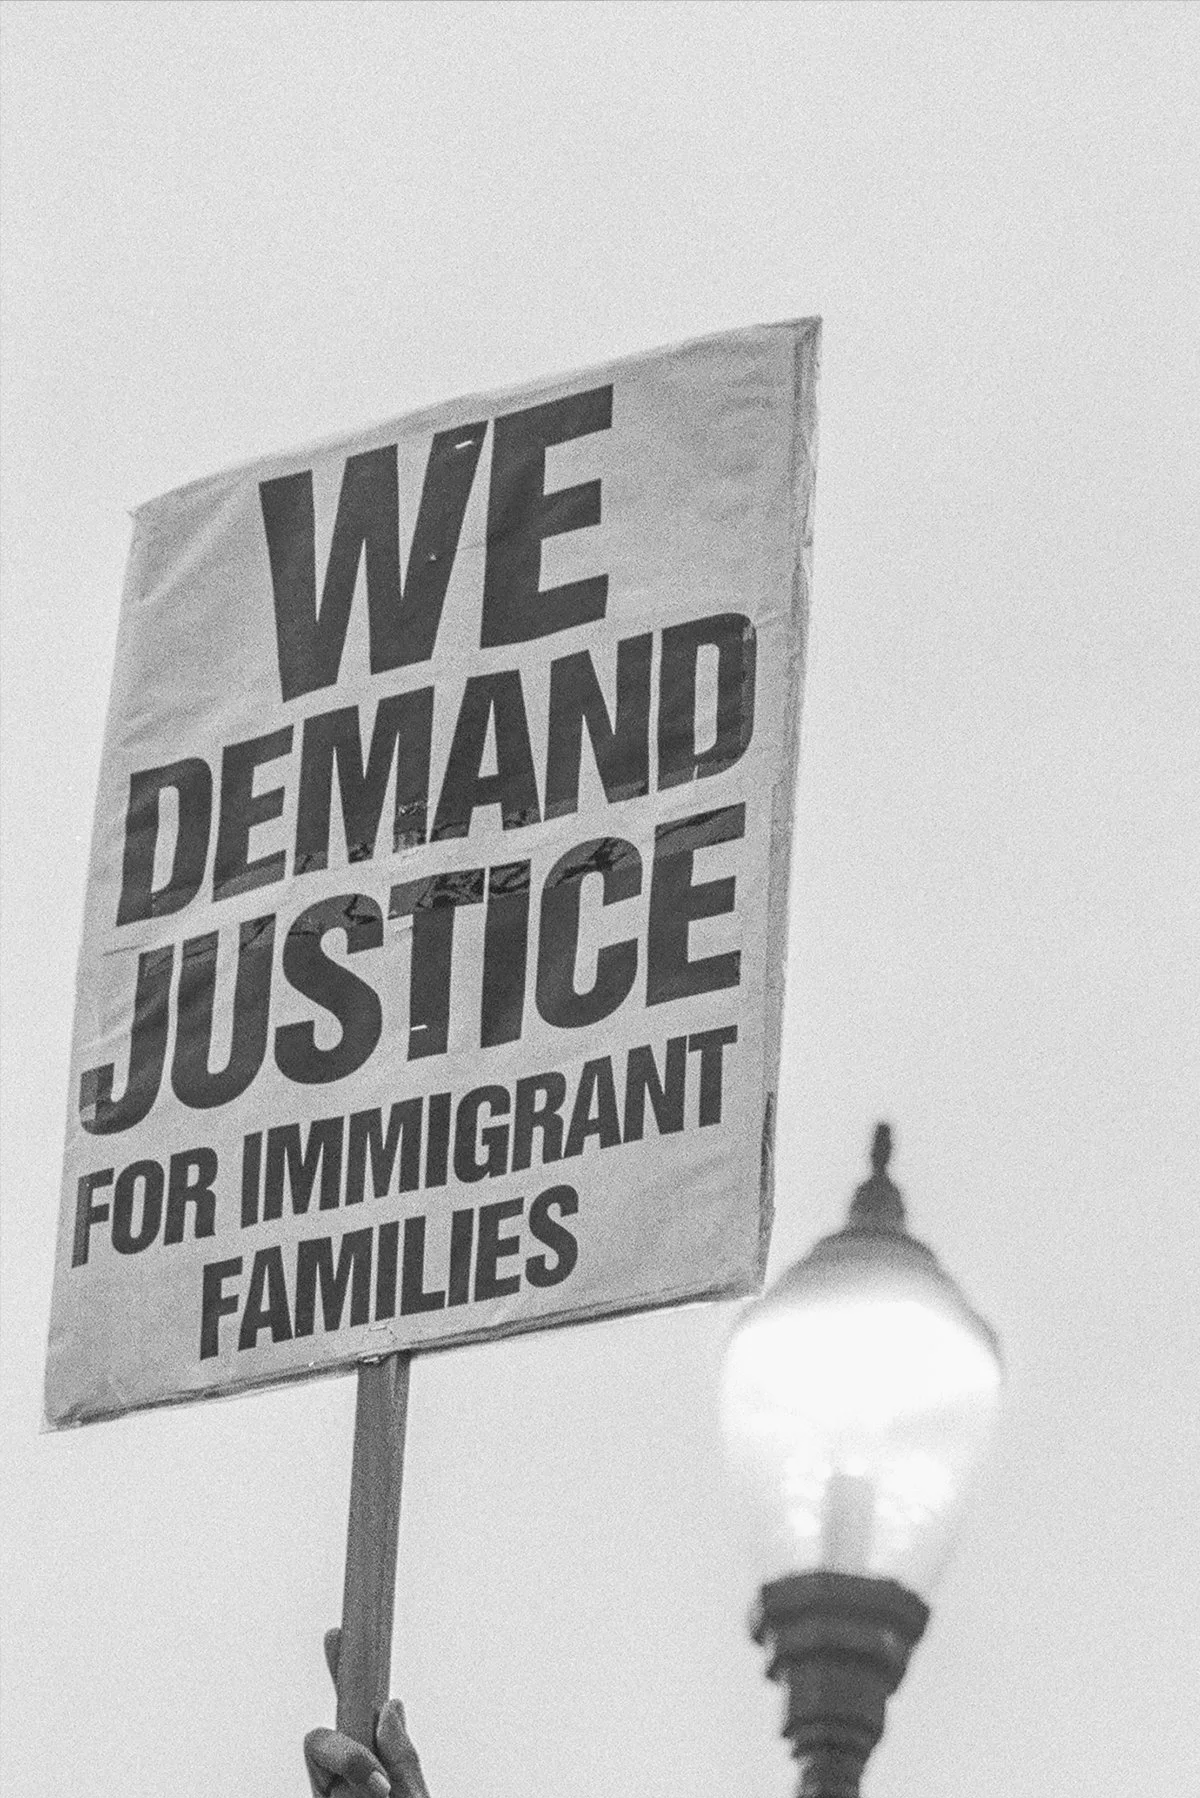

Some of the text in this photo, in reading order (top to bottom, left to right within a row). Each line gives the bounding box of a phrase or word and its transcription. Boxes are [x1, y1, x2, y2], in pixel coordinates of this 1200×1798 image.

[259, 384, 615, 703] WE
[116, 613, 757, 926] DEMAND
[79, 803, 747, 1136] JUSTICE
[71, 1025, 738, 1268] FOR IMMIGRANT
[200, 1185, 579, 1361] FAMILIES
